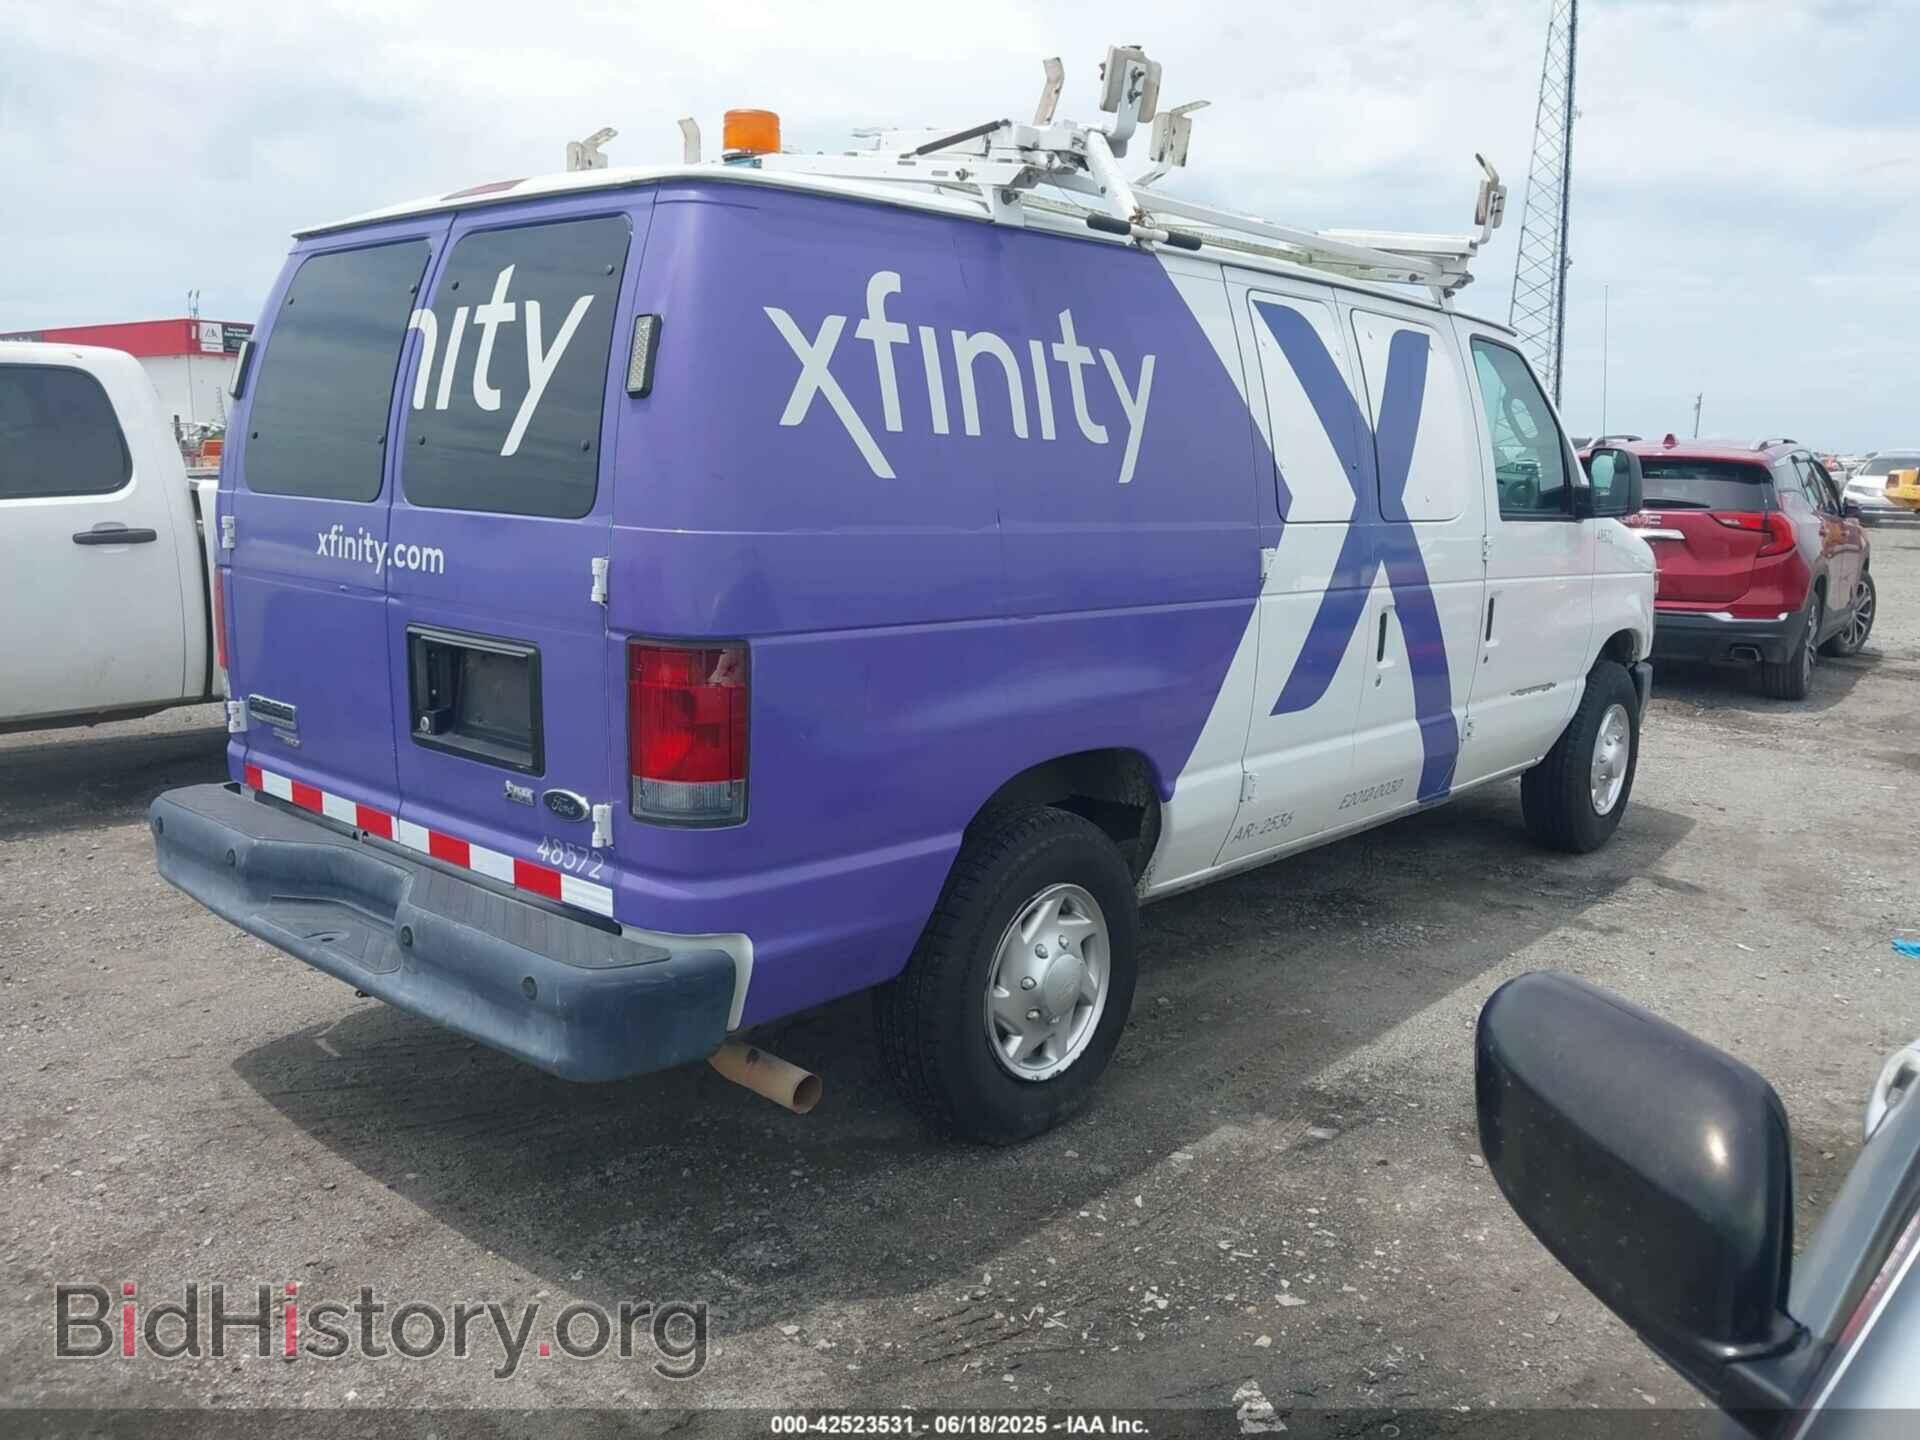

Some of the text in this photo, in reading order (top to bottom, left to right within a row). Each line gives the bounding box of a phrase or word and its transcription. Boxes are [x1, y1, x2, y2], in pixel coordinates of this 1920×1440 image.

[408, 264, 595, 456] nity
[762, 270, 1156, 483] xfinity
[316, 524, 444, 575] xfinity.com
[537, 835, 605, 880] 48572
